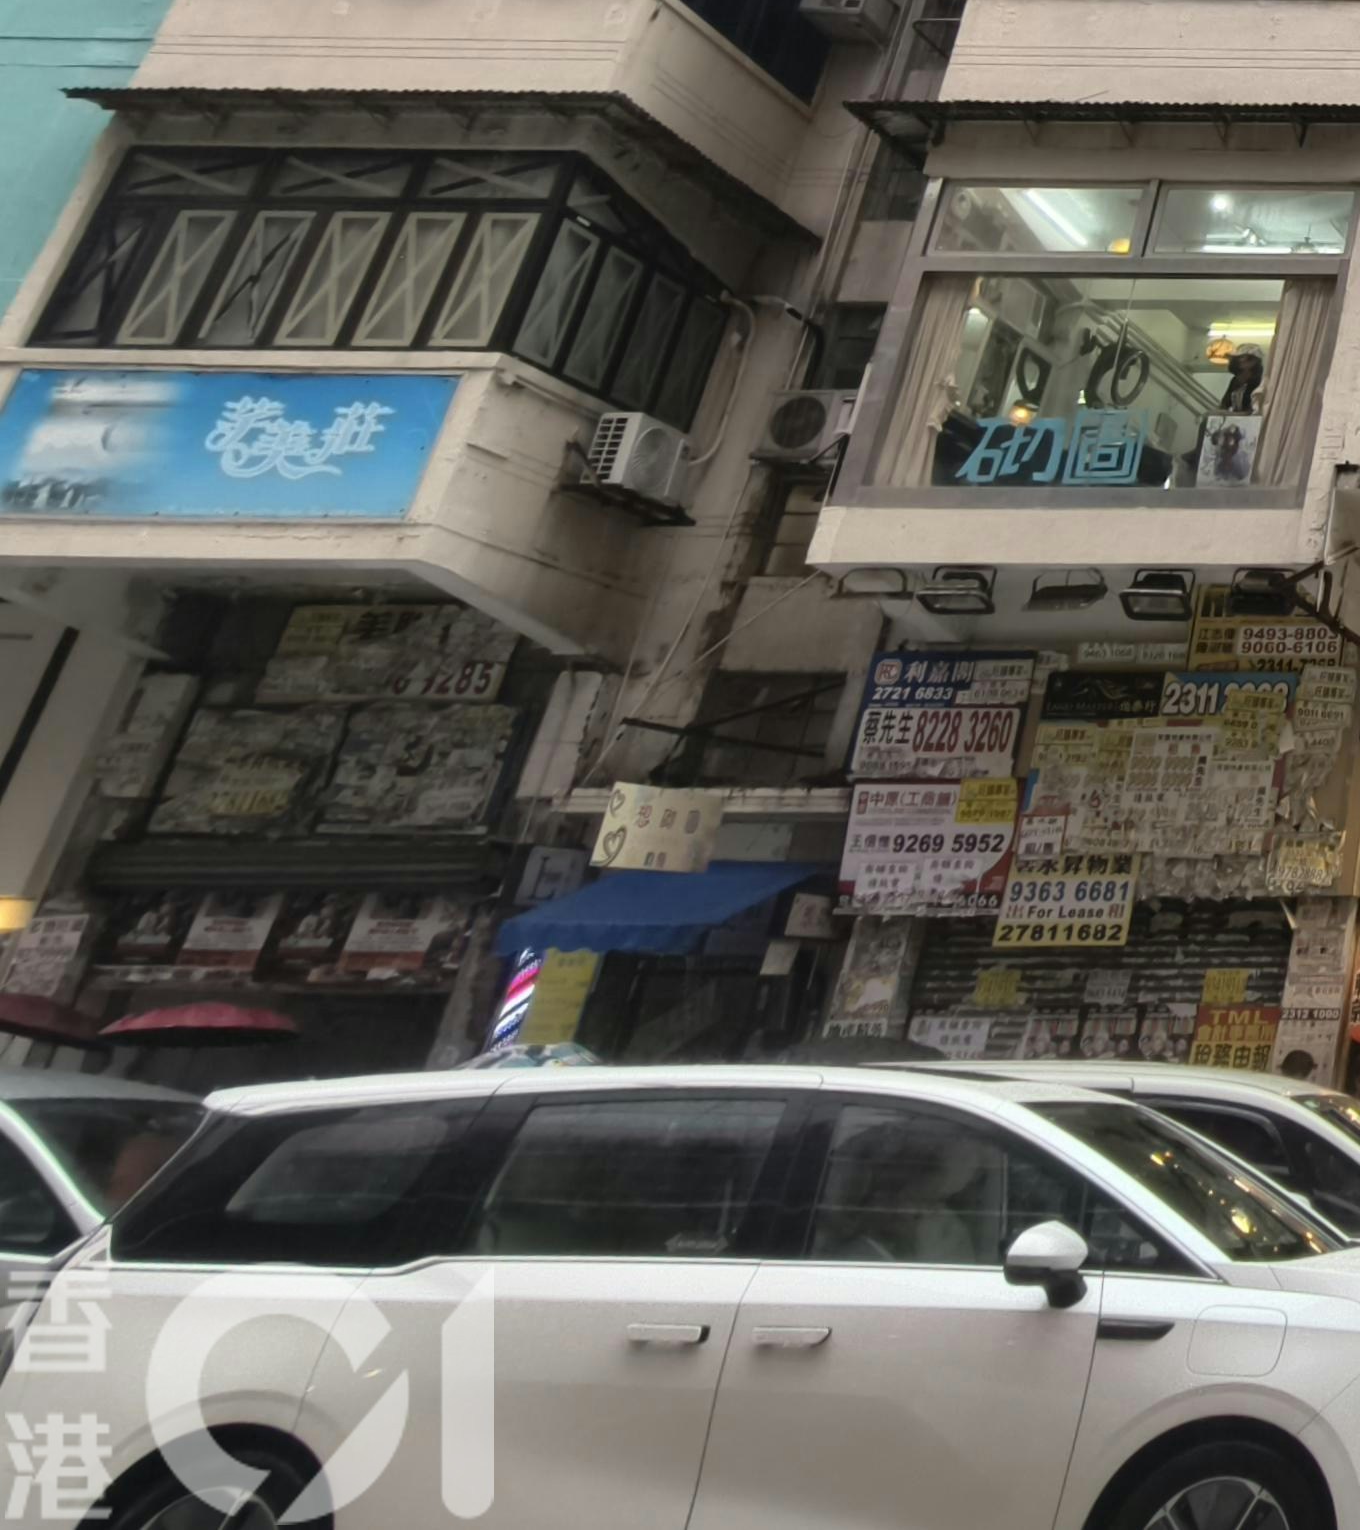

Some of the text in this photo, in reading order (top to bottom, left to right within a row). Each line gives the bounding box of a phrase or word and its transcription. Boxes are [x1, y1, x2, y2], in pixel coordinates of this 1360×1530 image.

[1242, 641, 1338, 654] 9060-6106
[872, 687, 954, 700] 2721 6833
[1162, 682, 1218, 714] 2311
[912, 710, 963, 752] 8228
[964, 710, 1014, 753] 3260
[892, 833, 945, 854] 9269
[951, 833, 1005, 853] 5952
[1009, 881, 1129, 902] 9363 6681
[1026, 905, 1104, 919] For Lease
[998, 924, 1123, 942] 27811682
[1207, 1010, 1270, 1025] TML
